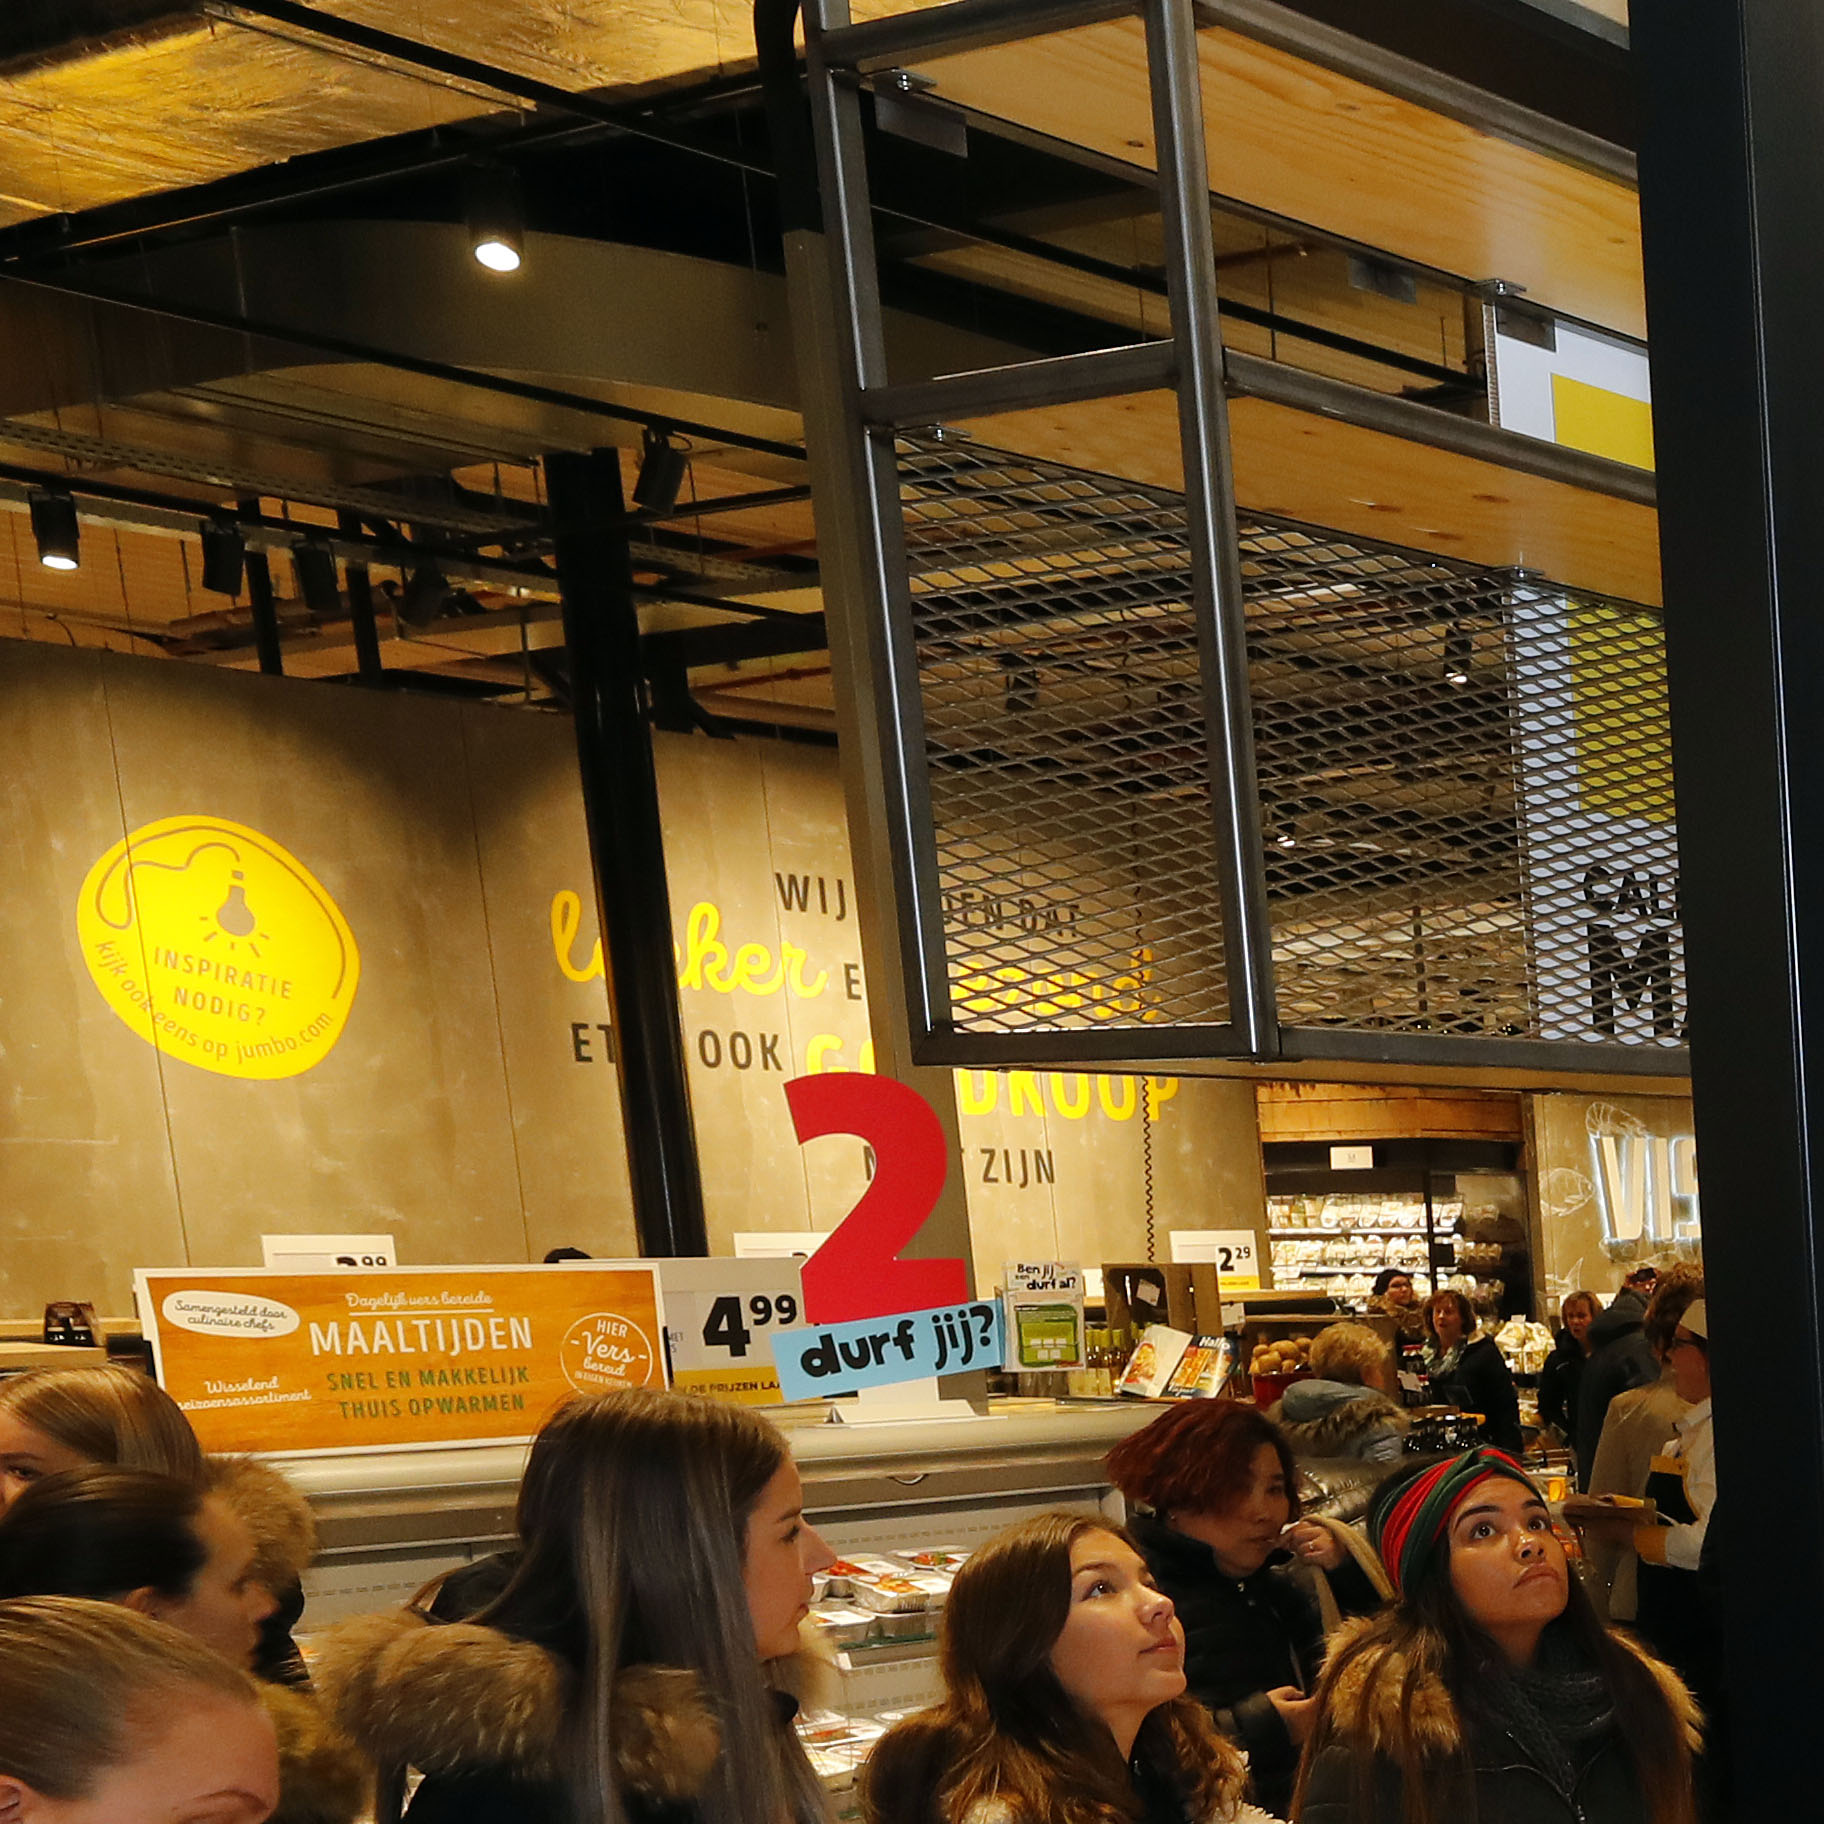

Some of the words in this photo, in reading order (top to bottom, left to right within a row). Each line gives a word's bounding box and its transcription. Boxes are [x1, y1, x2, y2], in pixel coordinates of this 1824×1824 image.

[775, 872, 848, 921] WIJ
[154, 947, 293, 1000] INSPIRATIE
[96, 940, 128, 977] kijk
[120, 978, 153, 1013] ook
[153, 1011, 199, 1047] eens
[203, 1040, 228, 1061] op
[237, 1012, 334, 1064] jumbo.com
[174, 986, 267, 1026] NODIG?
[699, 1029, 783, 1073] OOK
[980, 1148, 1056, 1189] ZIJN
[784, 1071, 968, 1326] 2
[1016, 1263, 1040, 1275] Ben
[1041, 1263, 1056, 1281] jij
[1026, 1279, 1056, 1291] durf
[174, 1299, 258, 1318] Samengesteld
[259, 1307, 288, 1320] door
[441, 1291, 494, 1306] bereide
[187, 1314, 242, 1329] culinaire
[243, 1317, 276, 1333] chefs
[308, 1316, 533, 1357] MAALTIJDEN
[597, 1318, 628, 1339] HIER
[580, 1330, 636, 1364] Vers
[799, 1319, 916, 1379] durf
[930, 1304, 995, 1372] jij?
[326, 1371, 379, 1392] SNEL
[386, 1368, 411, 1389] EN
[418, 1365, 531, 1388] MAKKELIJK
[583, 1357, 627, 1378] bereid
[204, 1376, 280, 1395] Wisselend
[709, 1381, 759, 1393] PRIJZEN
[339, 1400, 402, 1420] THUIS
[408, 1395, 526, 1417] OPWARMEN
